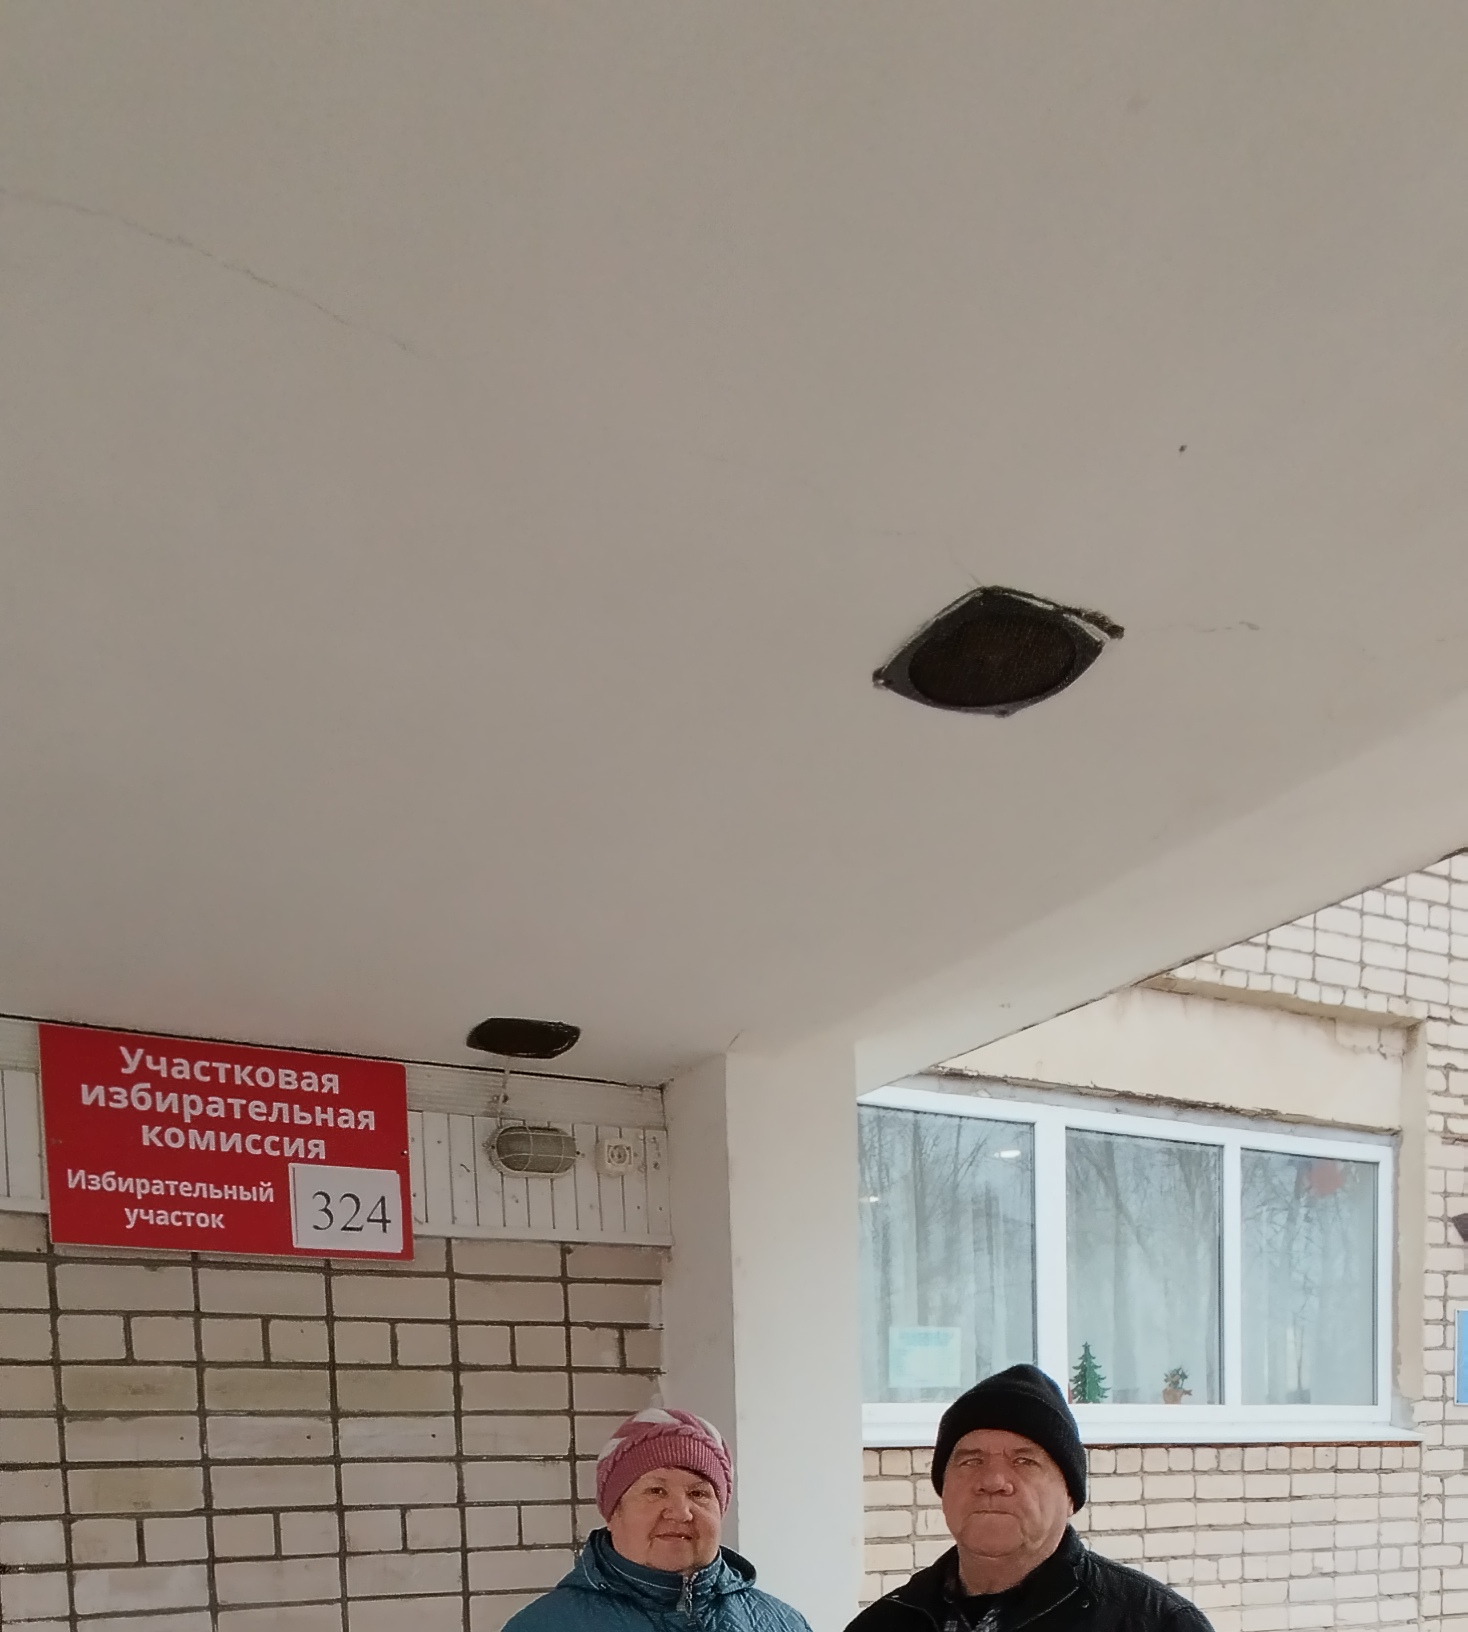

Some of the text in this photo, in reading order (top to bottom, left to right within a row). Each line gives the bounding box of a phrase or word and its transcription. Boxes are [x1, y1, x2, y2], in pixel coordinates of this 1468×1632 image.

[119, 1045, 340, 1095] Участковая
[81, 1083, 376, 1131] избирательная
[141, 1124, 326, 1160] комиссия
[67, 1168, 275, 1204] Избирательный
[124, 1207, 226, 1229] участок
[311, 1190, 392, 1234] 324
